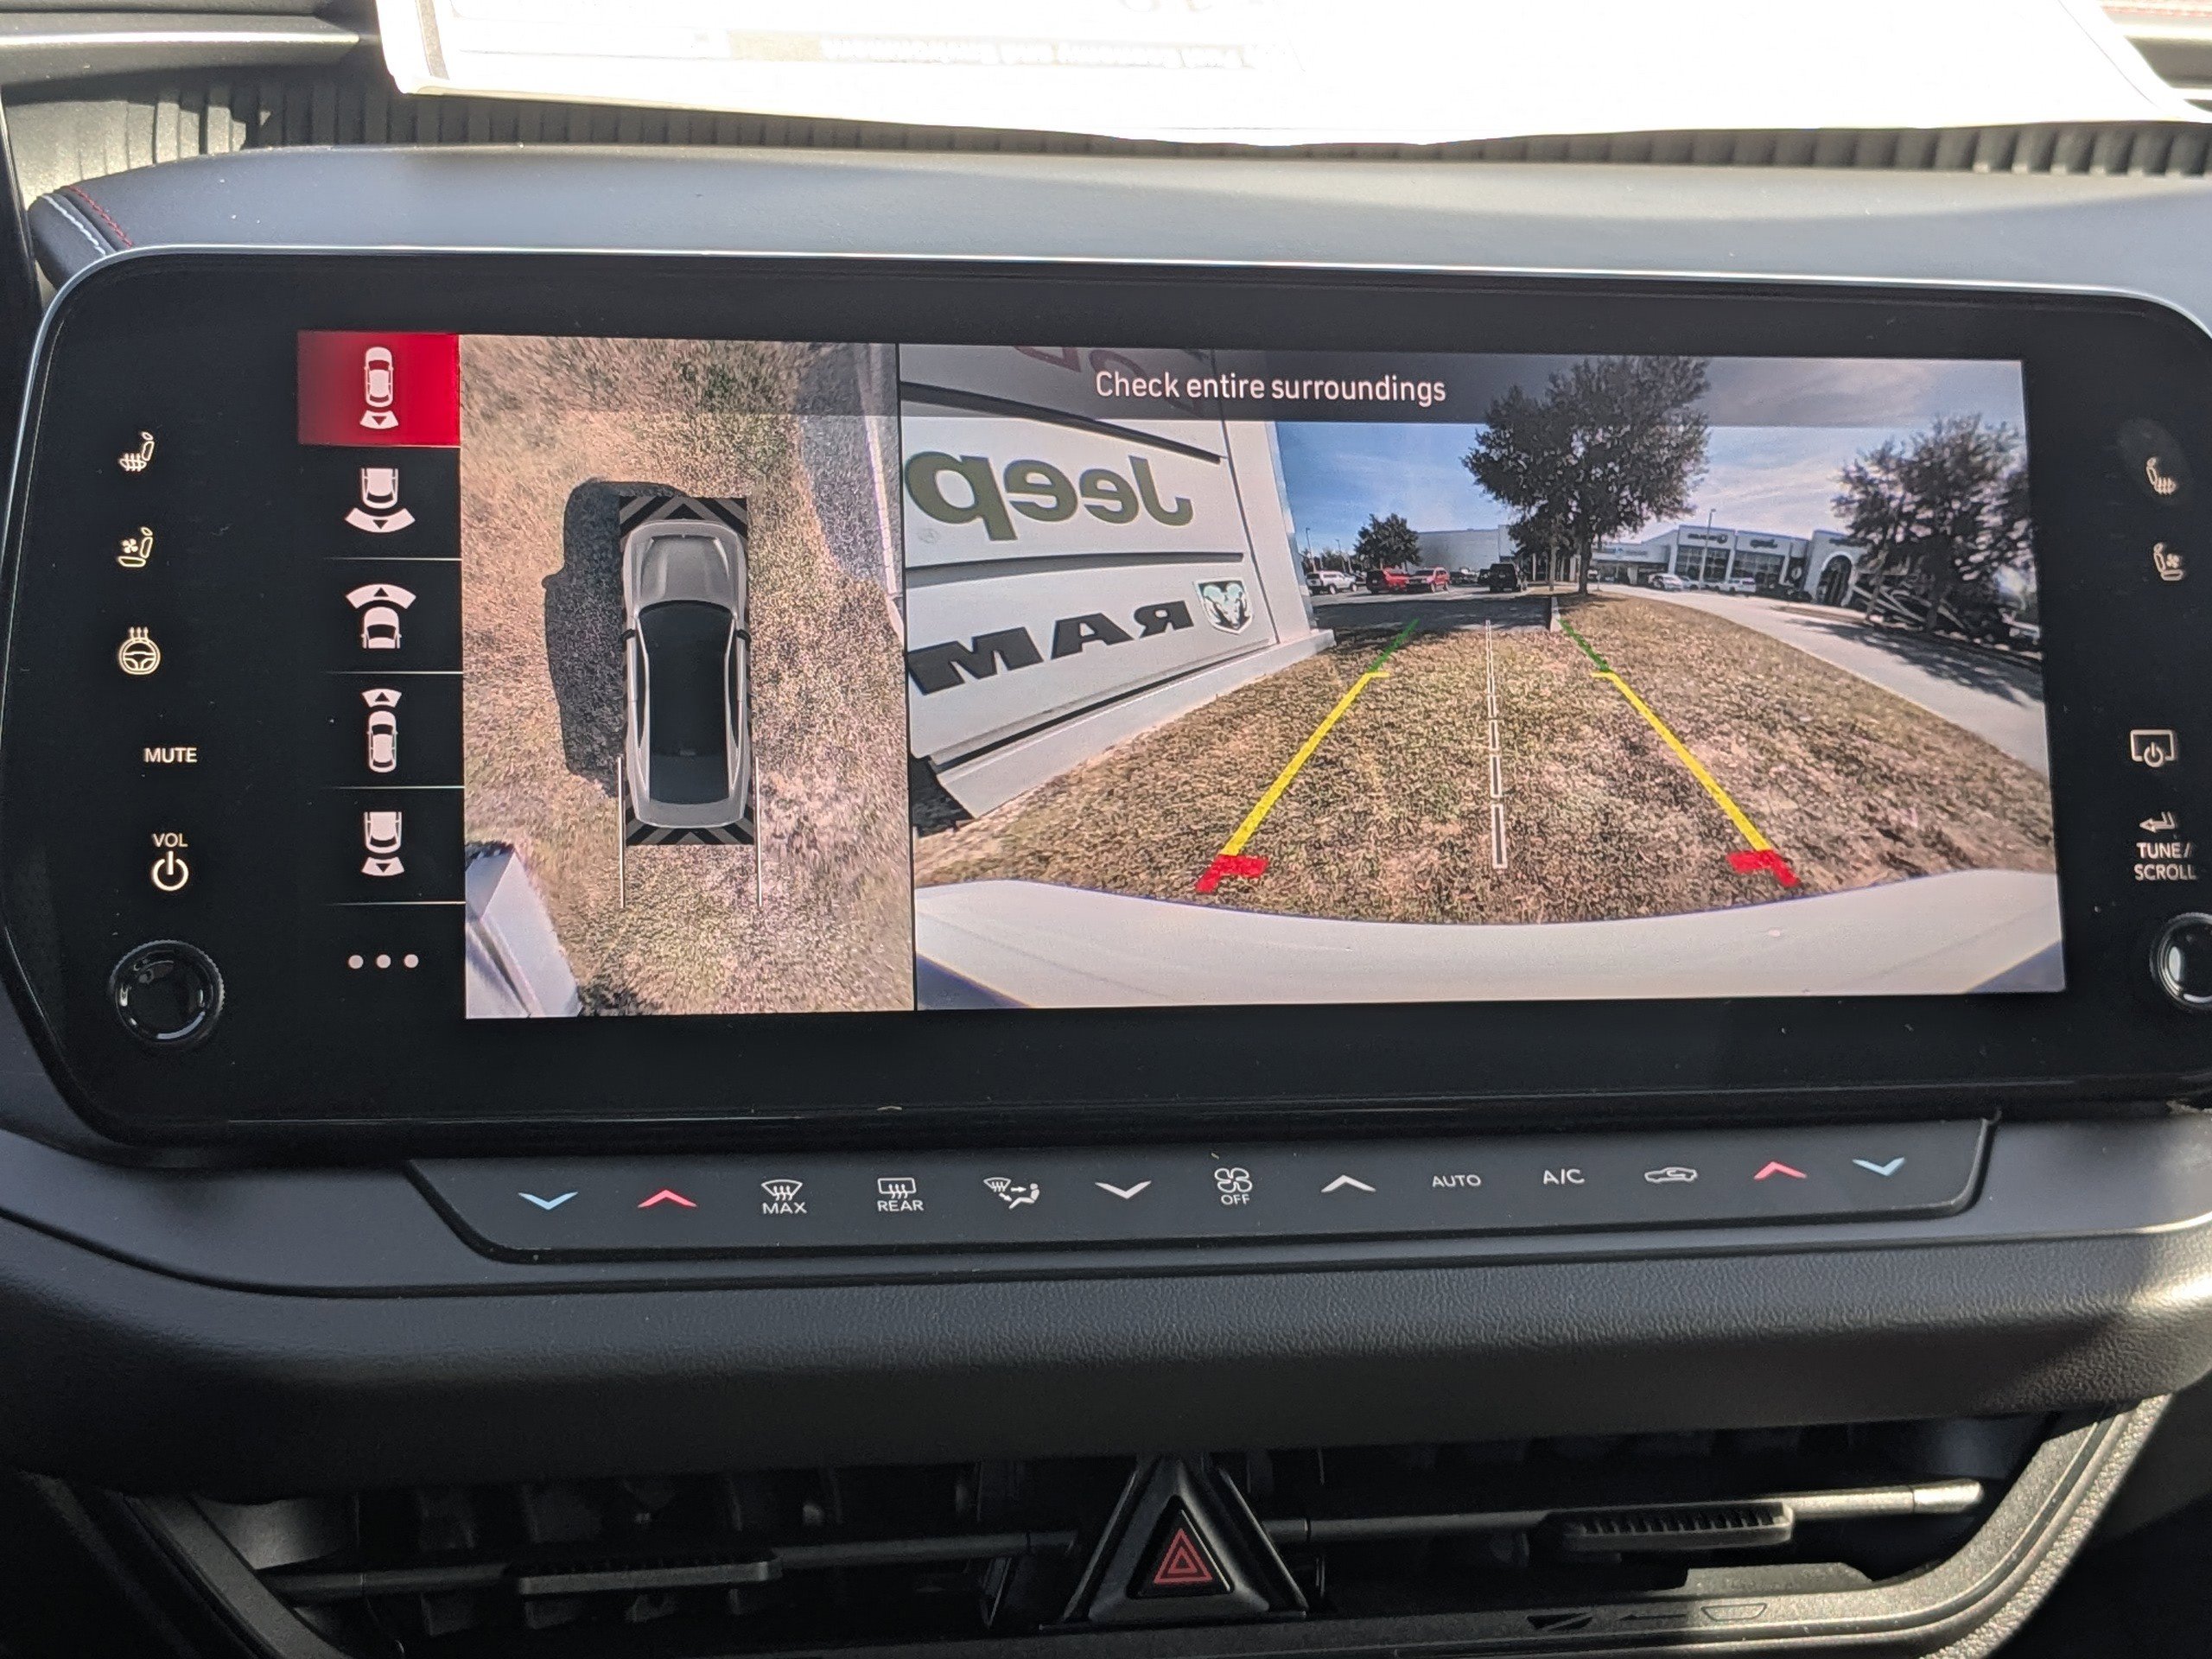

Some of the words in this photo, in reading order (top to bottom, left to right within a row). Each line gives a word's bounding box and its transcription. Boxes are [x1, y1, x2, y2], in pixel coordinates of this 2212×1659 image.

[1095, 371, 1180, 401] Check
[1186, 375, 1266, 402] entire
[1271, 375, 1447, 405] surroundings
[143, 747, 198, 763] MUTE
[151, 832, 188, 848] VOL
[2135, 842, 2191, 859] TUNE/
[2133, 863, 2197, 881] SCROLL
[1431, 1173, 1482, 1188] AUTO
[1542, 1168, 1586, 1185] A/C
[875, 1198, 925, 1212] REAR
[1220, 1193, 1251, 1205] OFF
[761, 1201, 808, 1215] MAX
